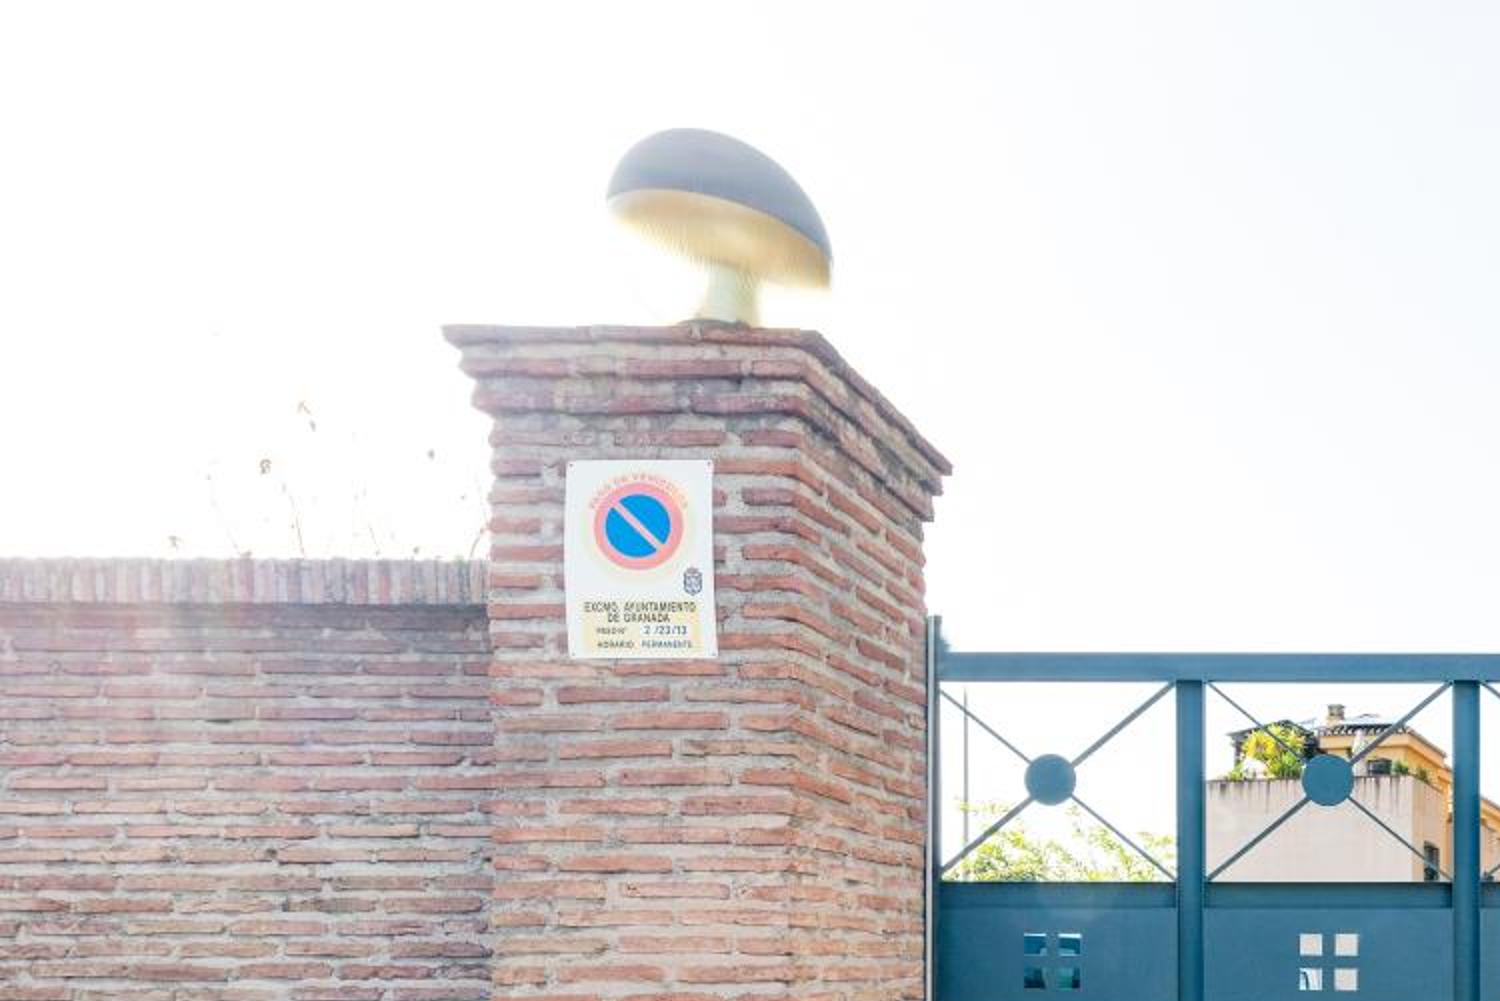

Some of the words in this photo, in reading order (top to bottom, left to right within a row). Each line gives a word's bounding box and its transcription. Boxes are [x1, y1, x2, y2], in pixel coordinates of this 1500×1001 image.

[624, 601, 697, 613] AYUNTAMIENTO
[607, 612, 620, 623] DE
[624, 612, 671, 623] GRANADA
